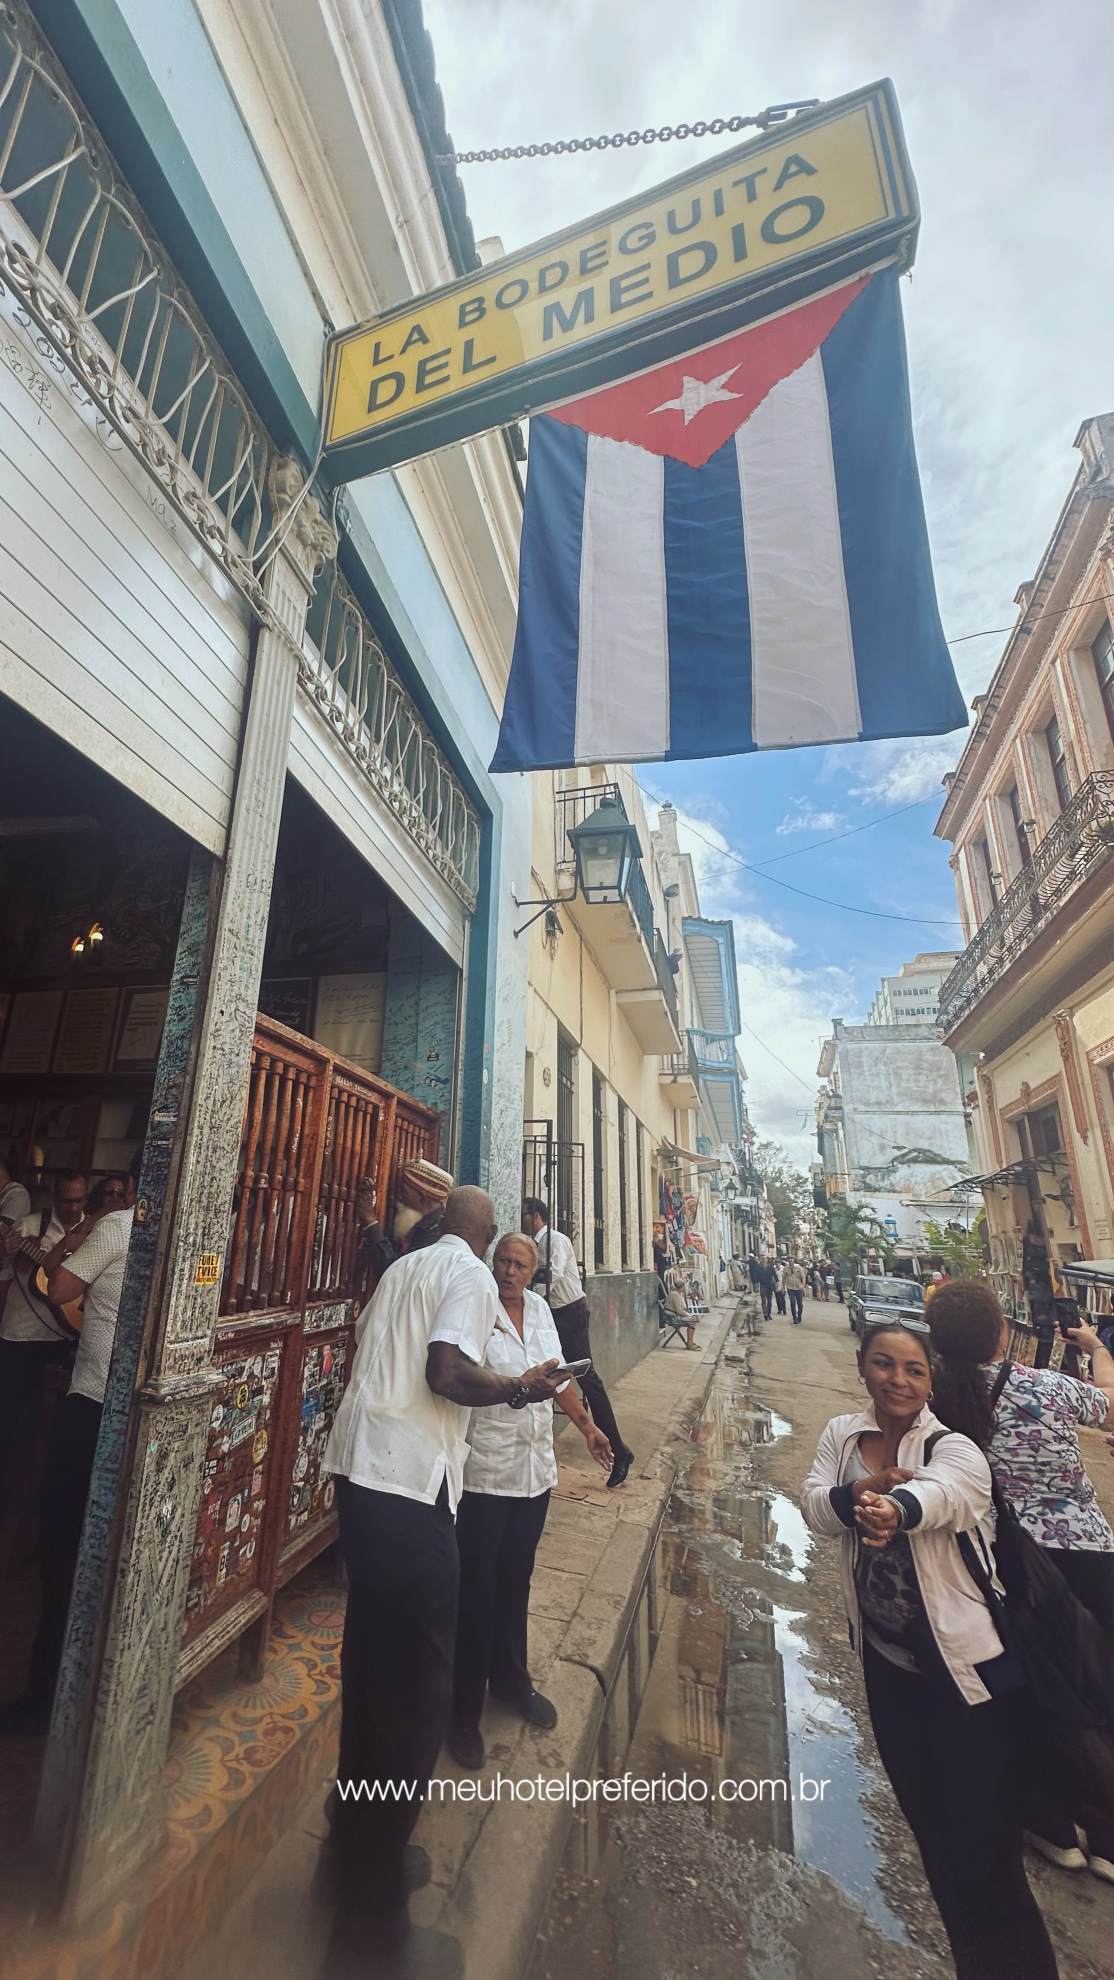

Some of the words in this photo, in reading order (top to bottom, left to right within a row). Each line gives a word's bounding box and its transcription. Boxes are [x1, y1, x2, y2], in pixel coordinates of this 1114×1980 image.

[366, 352, 497, 415] DEL
[541, 194, 826, 342] MEDIO
[371, 326, 430, 367] LA
[457, 153, 819, 330] BODEGUITA
